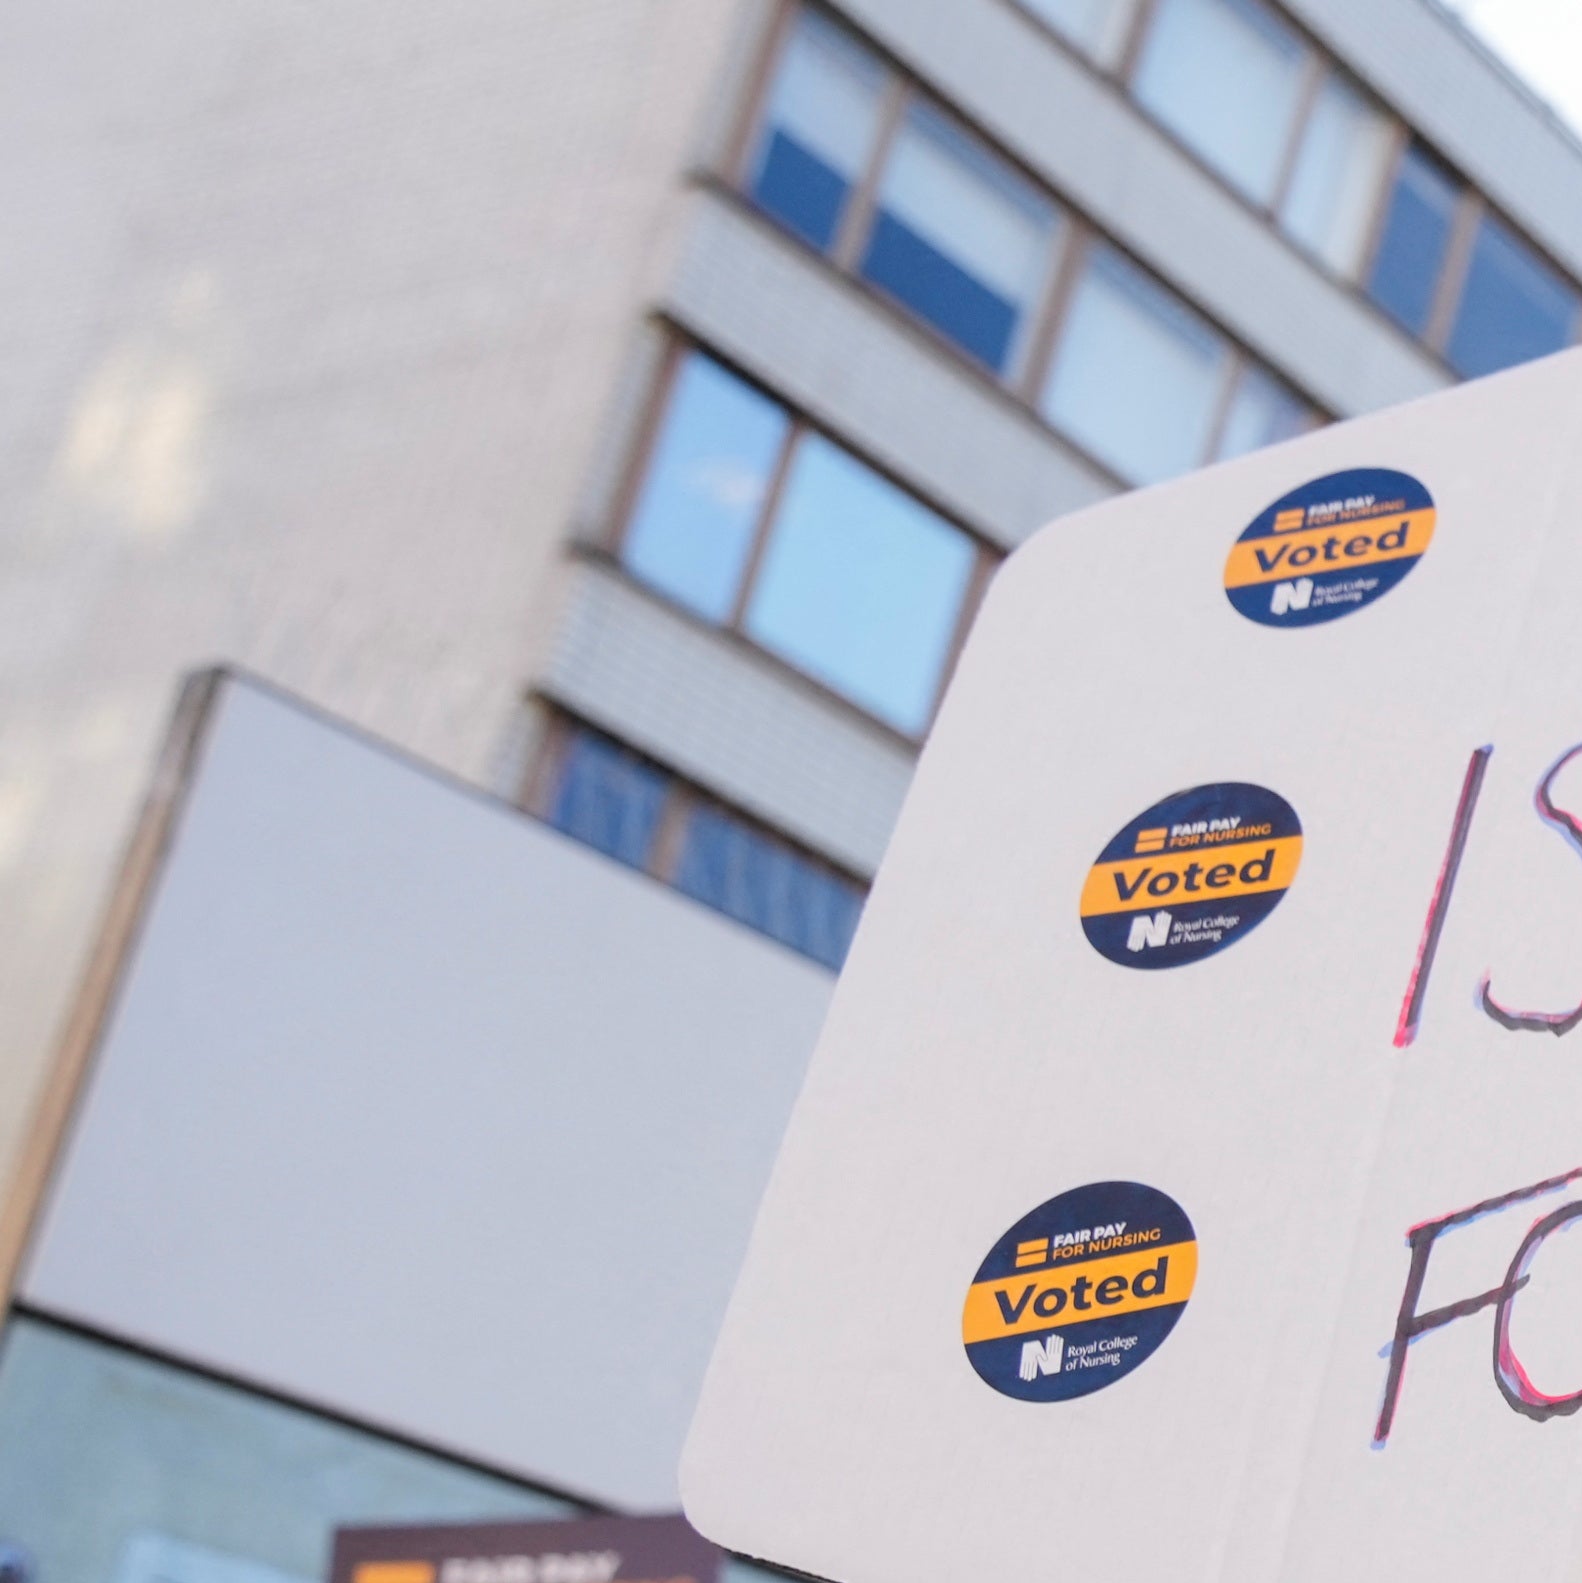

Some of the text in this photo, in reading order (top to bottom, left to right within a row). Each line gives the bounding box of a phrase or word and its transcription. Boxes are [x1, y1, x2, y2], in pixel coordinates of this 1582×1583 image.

[1255, 520, 1410, 572] Voted
[1169, 823, 1272, 848] FOR NURSING
[1171, 816, 1241, 837] FAIR PAY
[1113, 848, 1276, 902] Voted
[1170, 928, 1222, 945] of Nursing
[1173, 914, 1240, 934] Royal College
[1053, 1228, 1161, 1260] FOR NURSING
[1054, 1222, 1127, 1248] FAIR PAY
[995, 1256, 1168, 1325] Voted
[1068, 1335, 1138, 1359] Royal College
[1065, 1351, 1120, 1371] of Nursing
